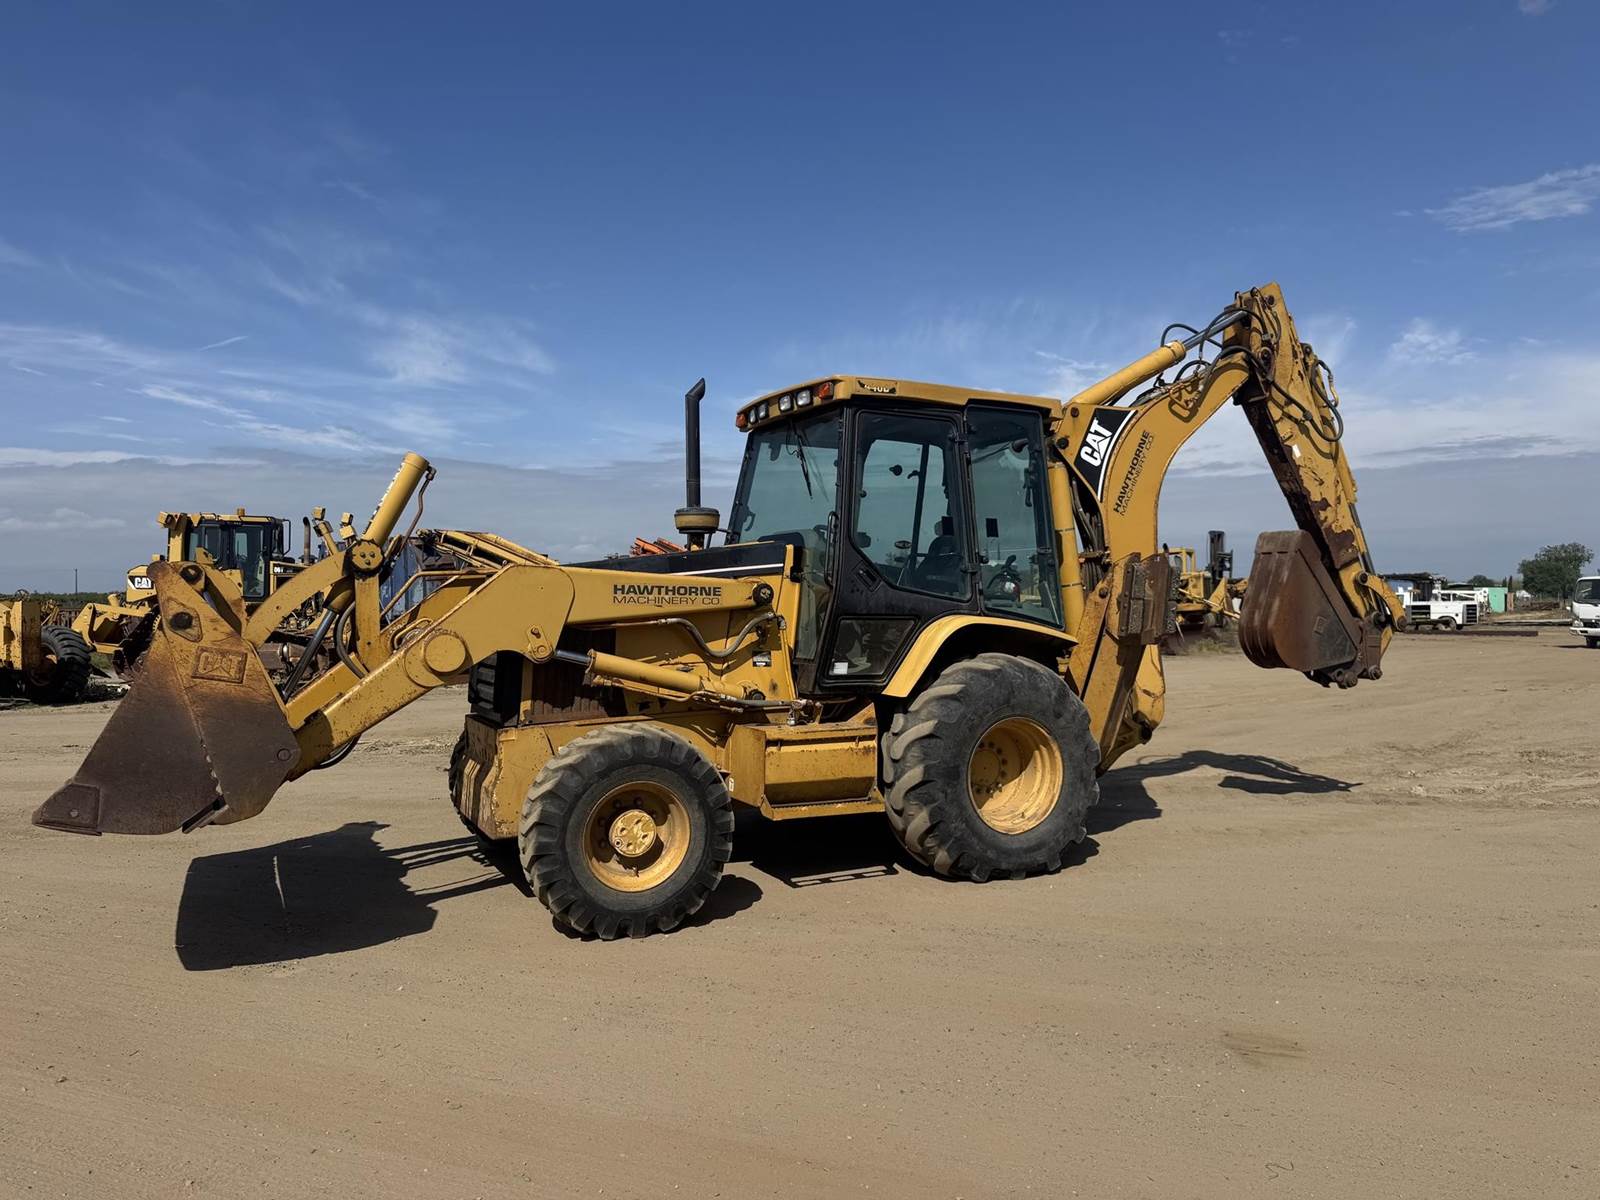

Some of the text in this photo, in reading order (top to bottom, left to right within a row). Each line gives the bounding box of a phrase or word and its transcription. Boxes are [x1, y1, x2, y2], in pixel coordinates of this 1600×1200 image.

[1080, 417, 1113, 467] CAT
[1113, 430, 1149, 513] HAWTHORNE
[1120, 453, 1146, 516] MACHINERY
[134, 577, 152, 588] CAT
[613, 584, 721, 596] HAWTHORNE
[613, 596, 697, 605] MACHINERY
[199, 651, 241, 679] CAT
